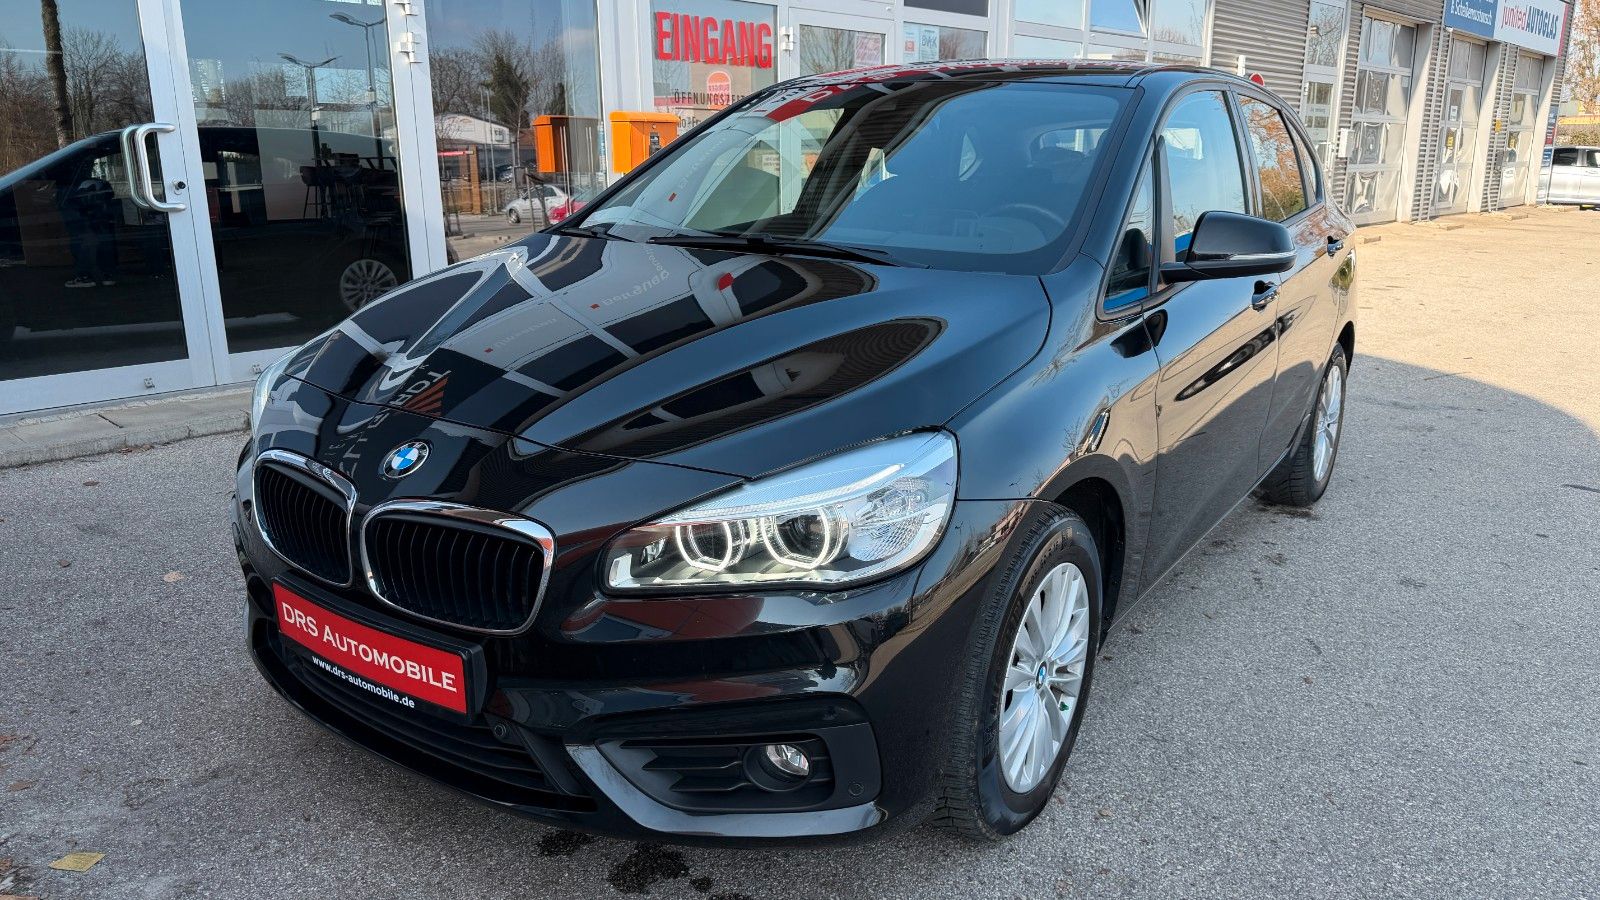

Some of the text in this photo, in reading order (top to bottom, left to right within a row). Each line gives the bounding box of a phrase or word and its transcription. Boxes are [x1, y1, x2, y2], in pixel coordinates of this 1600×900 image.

[655, 11, 772, 69] EINGANG
[1526, 6, 1559, 40] AUTOGLAS
[281, 602, 457, 693] DRS AUTOMOBILE
[311, 655, 415, 709] www.drs-automobile.de
